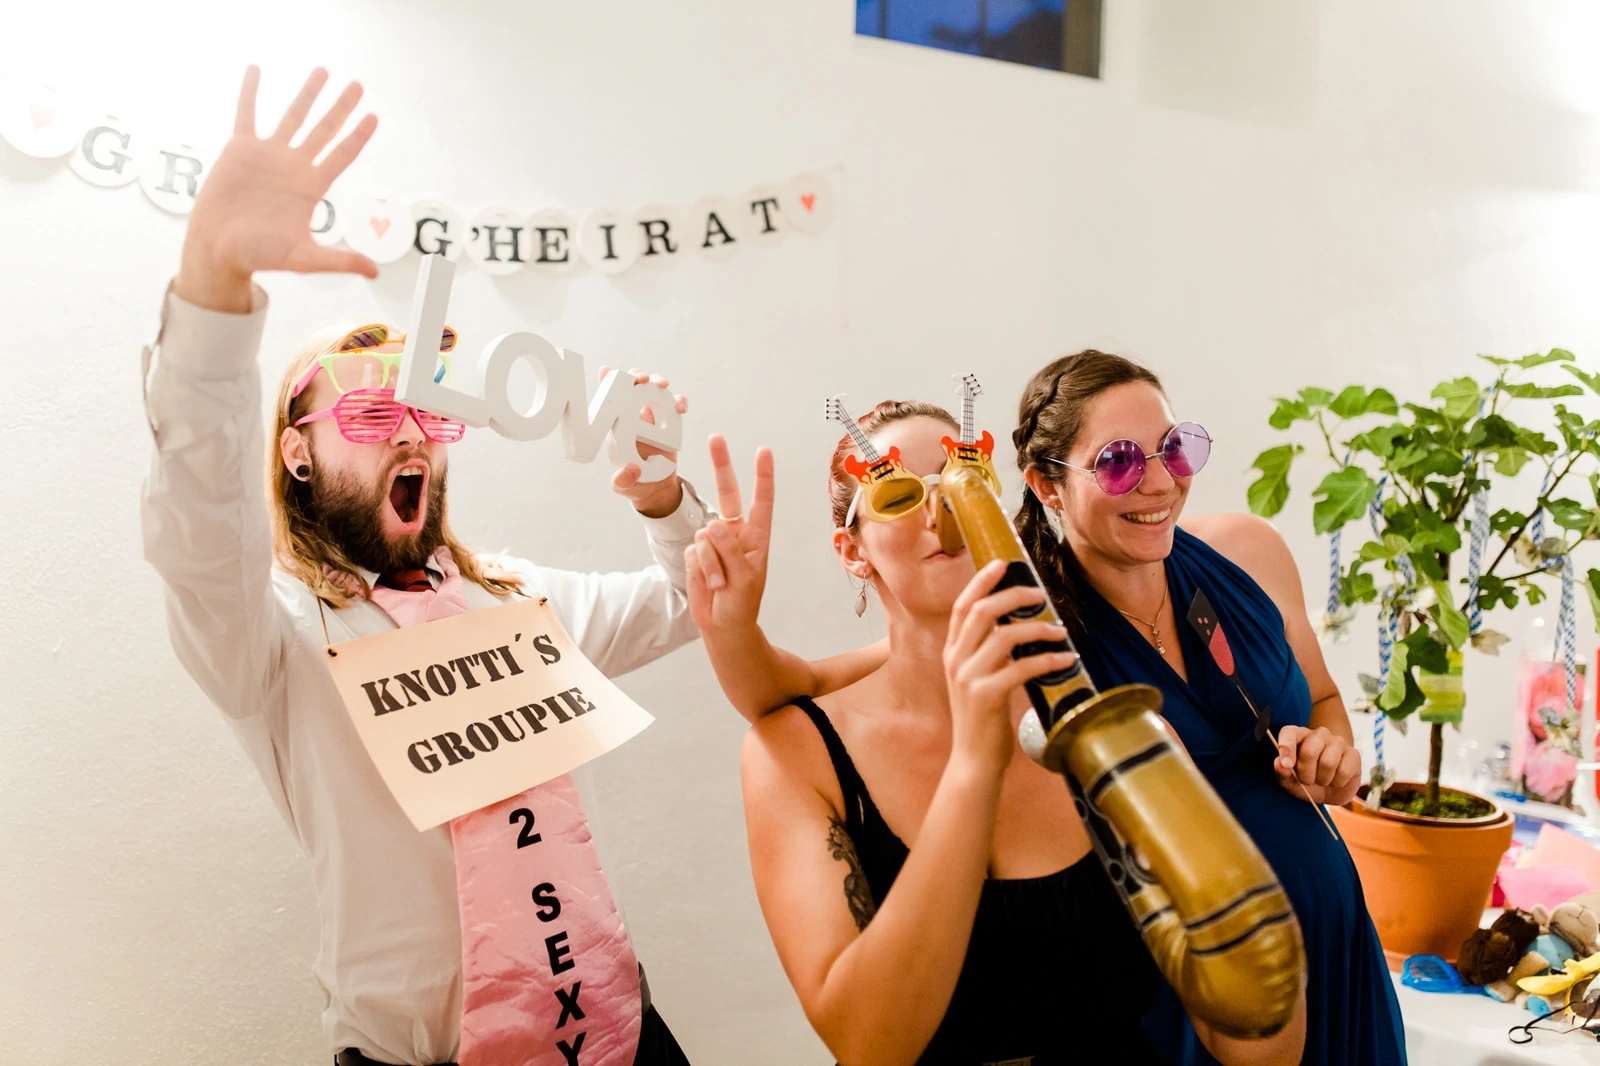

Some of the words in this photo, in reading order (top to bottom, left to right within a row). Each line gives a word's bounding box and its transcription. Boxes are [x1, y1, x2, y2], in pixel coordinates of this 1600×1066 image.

[407, 687, 596, 773] GROUPIE
[508, 807, 542, 849] 2
[531, 882, 587, 1066] SEXY
